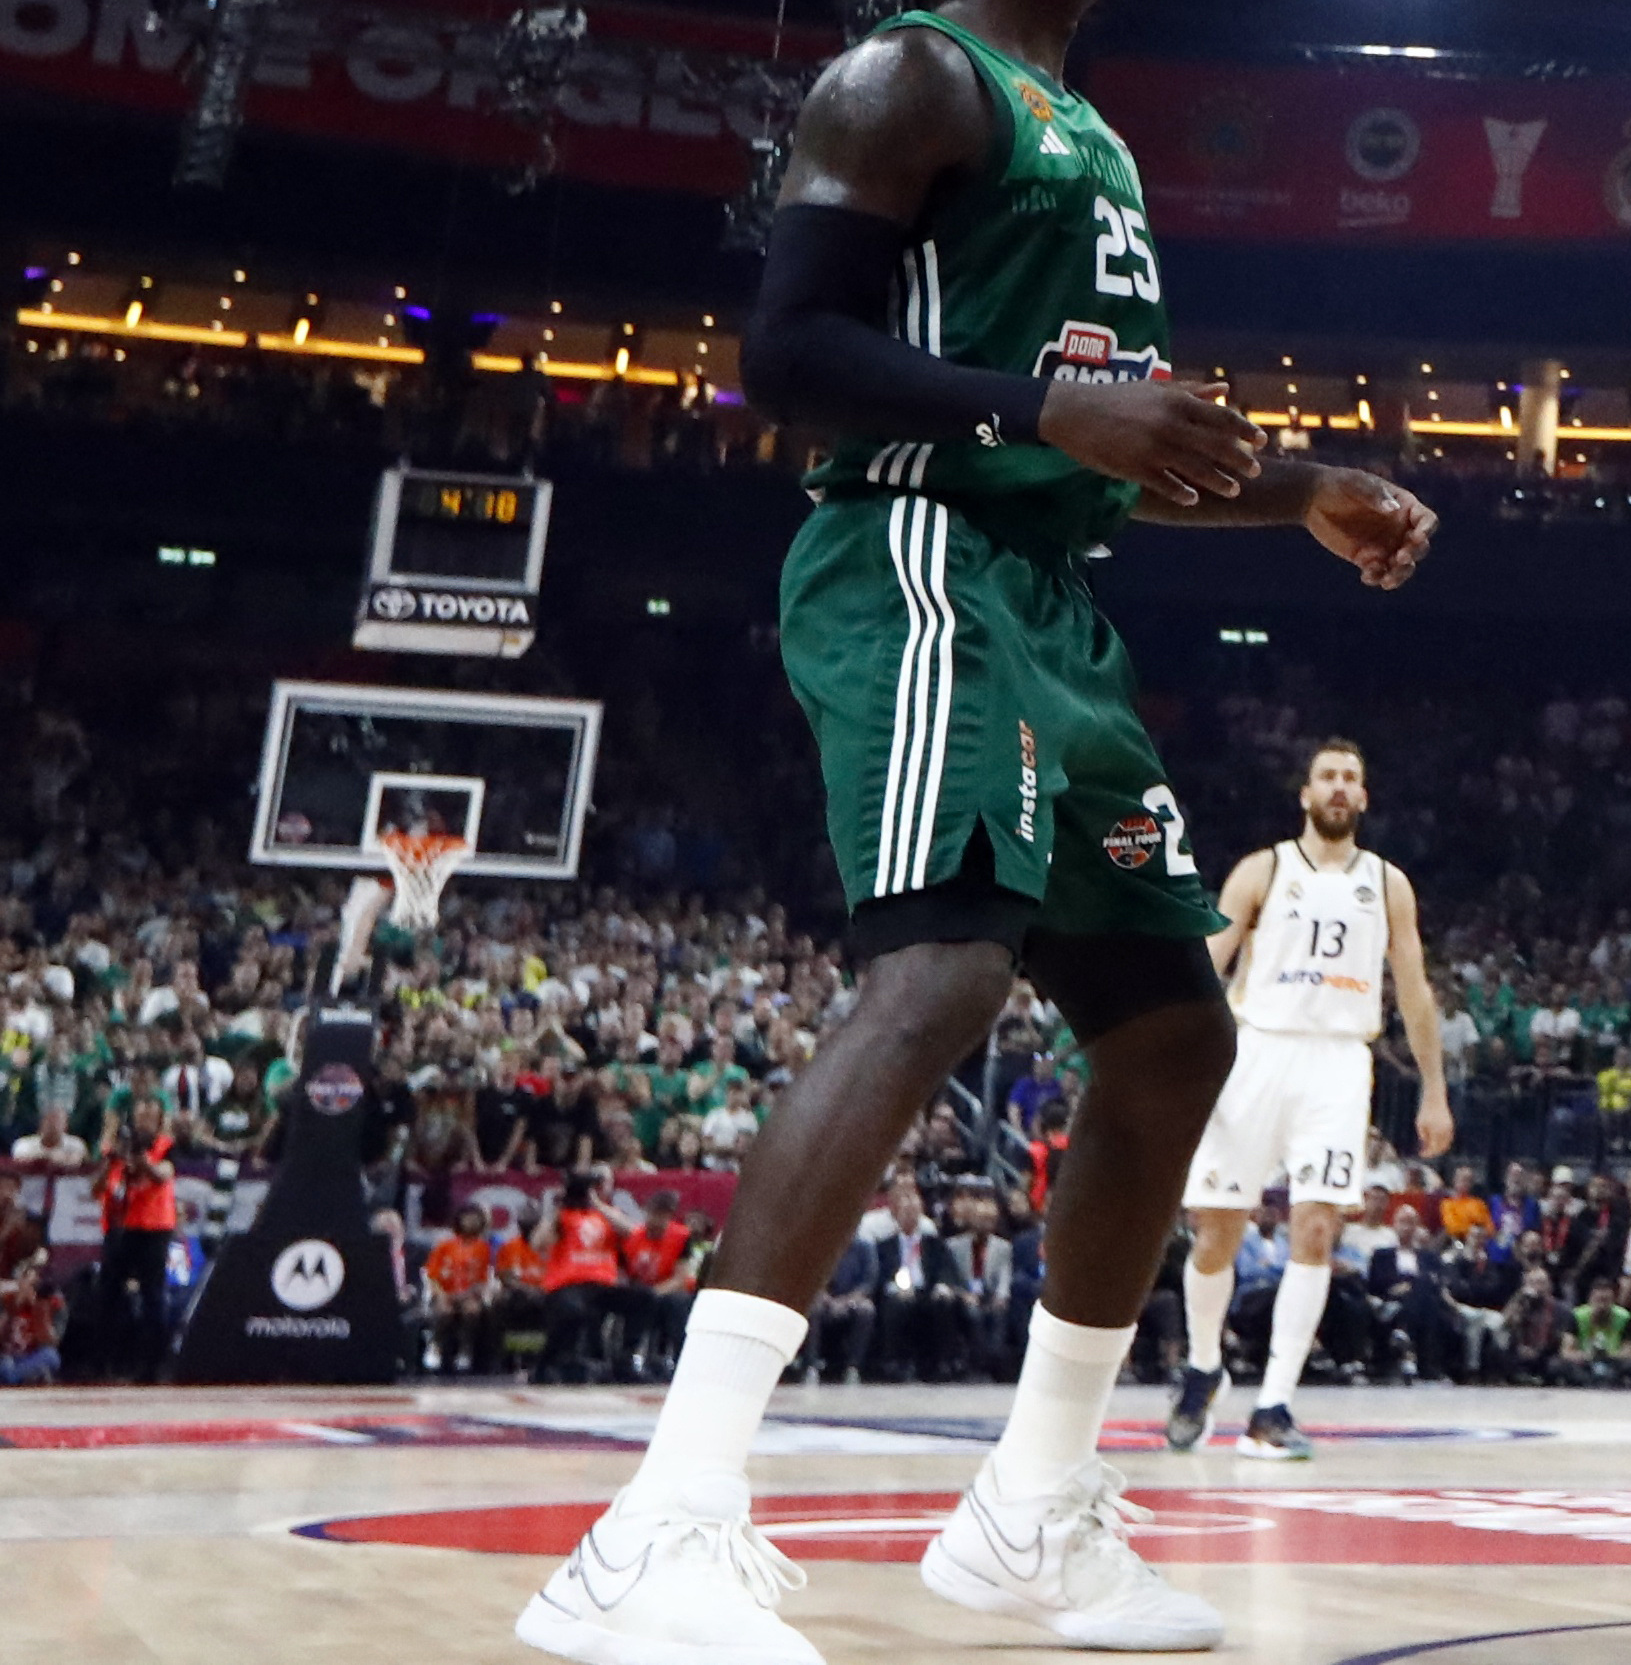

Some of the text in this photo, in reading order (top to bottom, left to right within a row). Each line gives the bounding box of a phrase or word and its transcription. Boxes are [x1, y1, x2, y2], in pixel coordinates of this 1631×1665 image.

[1094, 195, 1161, 304] 25
[1067, 334, 1105, 359] pame
[420, 592, 531, 624] TOYOTA
[1015, 718, 1037, 843] instacar
[1310, 919, 1348, 959] 13
[1321, 1147, 1354, 1189] 13
[245, 1315, 351, 1339] motorola
